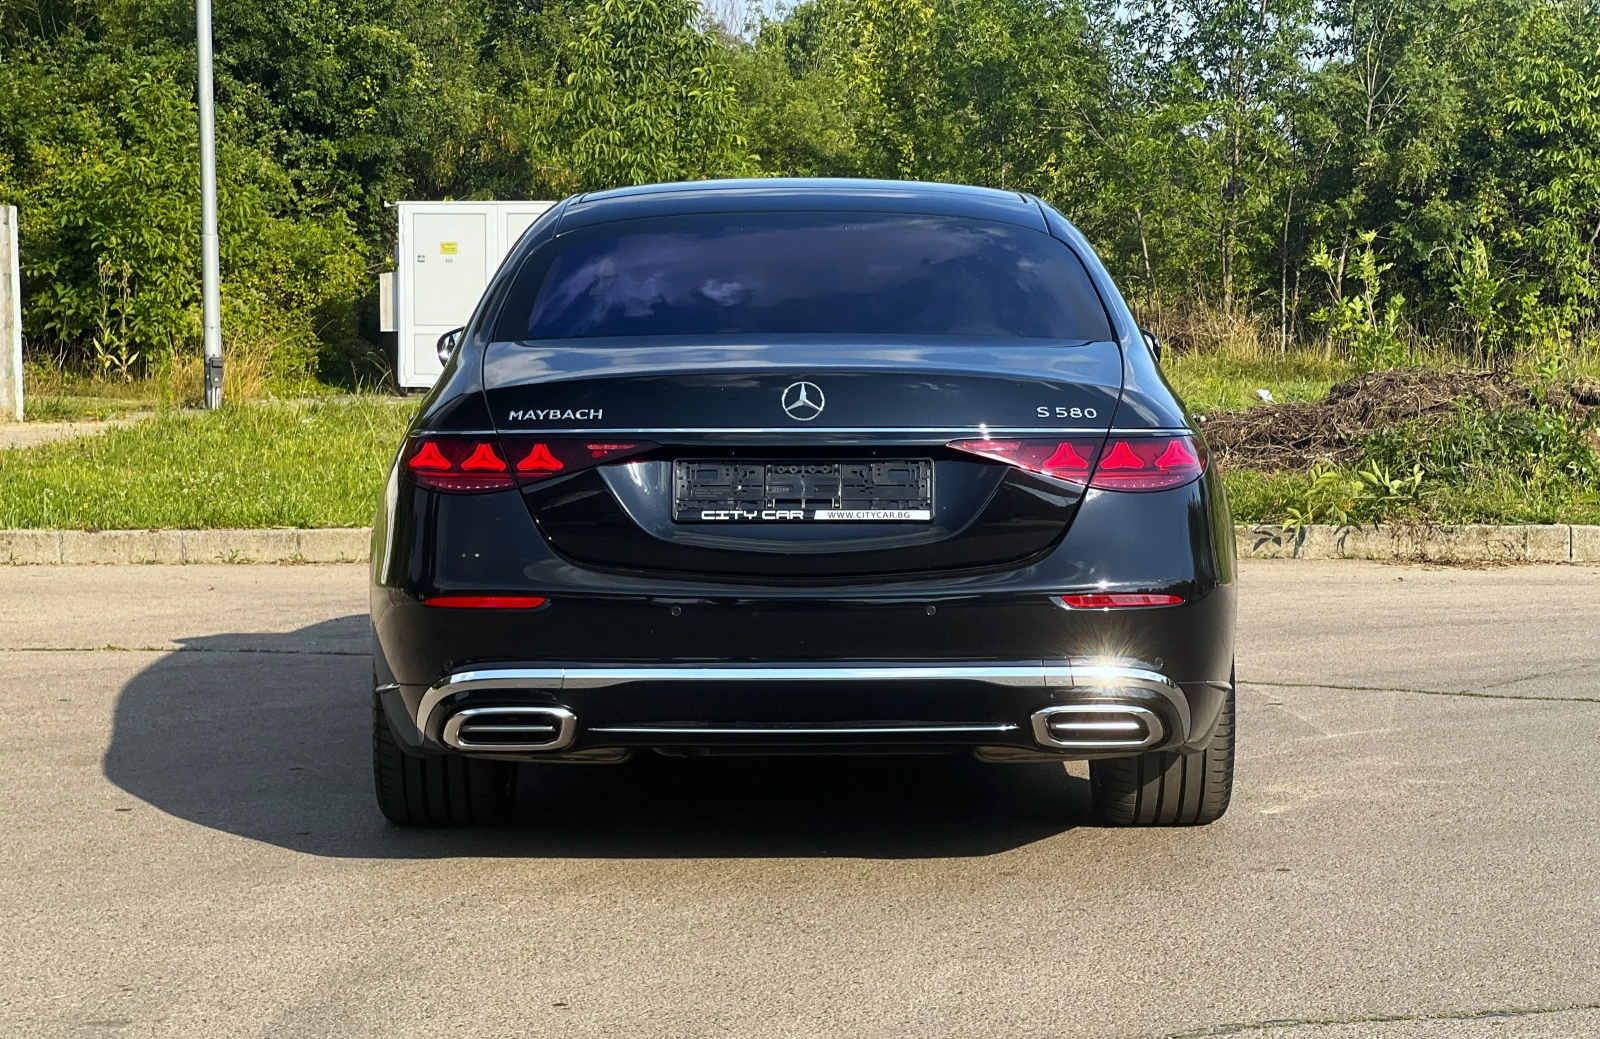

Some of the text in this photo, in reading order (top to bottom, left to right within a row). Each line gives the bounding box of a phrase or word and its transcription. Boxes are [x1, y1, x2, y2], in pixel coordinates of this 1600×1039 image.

[508, 408, 603, 420] MAYBACH
[1036, 406, 1098, 419] S 580
[701, 510, 804, 520] CITY CAR
[827, 511, 911, 519] WWW.CITYCAR.BG
